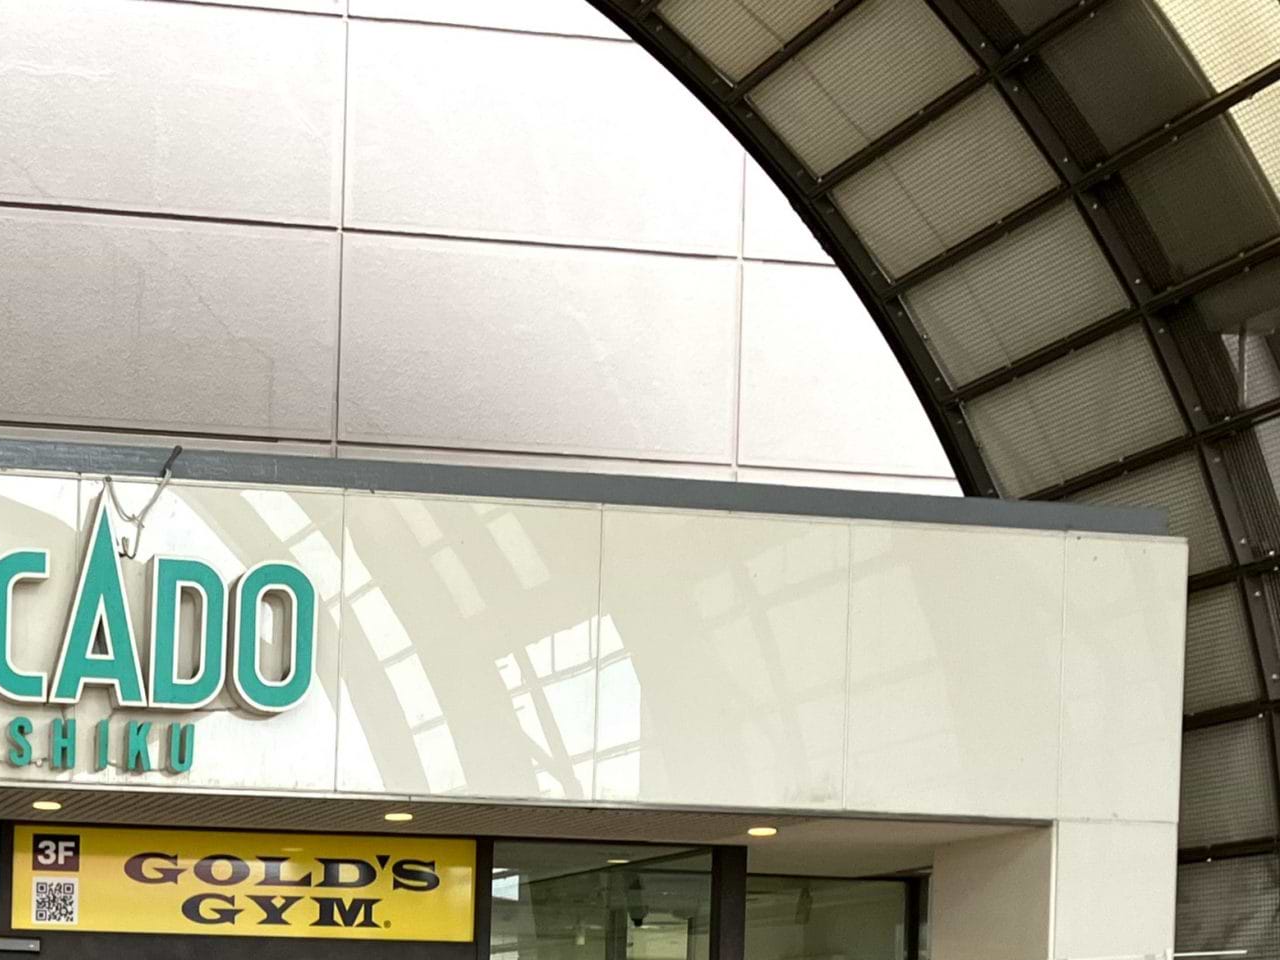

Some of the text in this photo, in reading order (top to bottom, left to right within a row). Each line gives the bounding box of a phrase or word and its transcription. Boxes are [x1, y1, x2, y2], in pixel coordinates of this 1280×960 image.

[37, 840, 75, 865] 3F
[124, 852, 441, 892] GOLD'S
[181, 892, 383, 929] GYM
